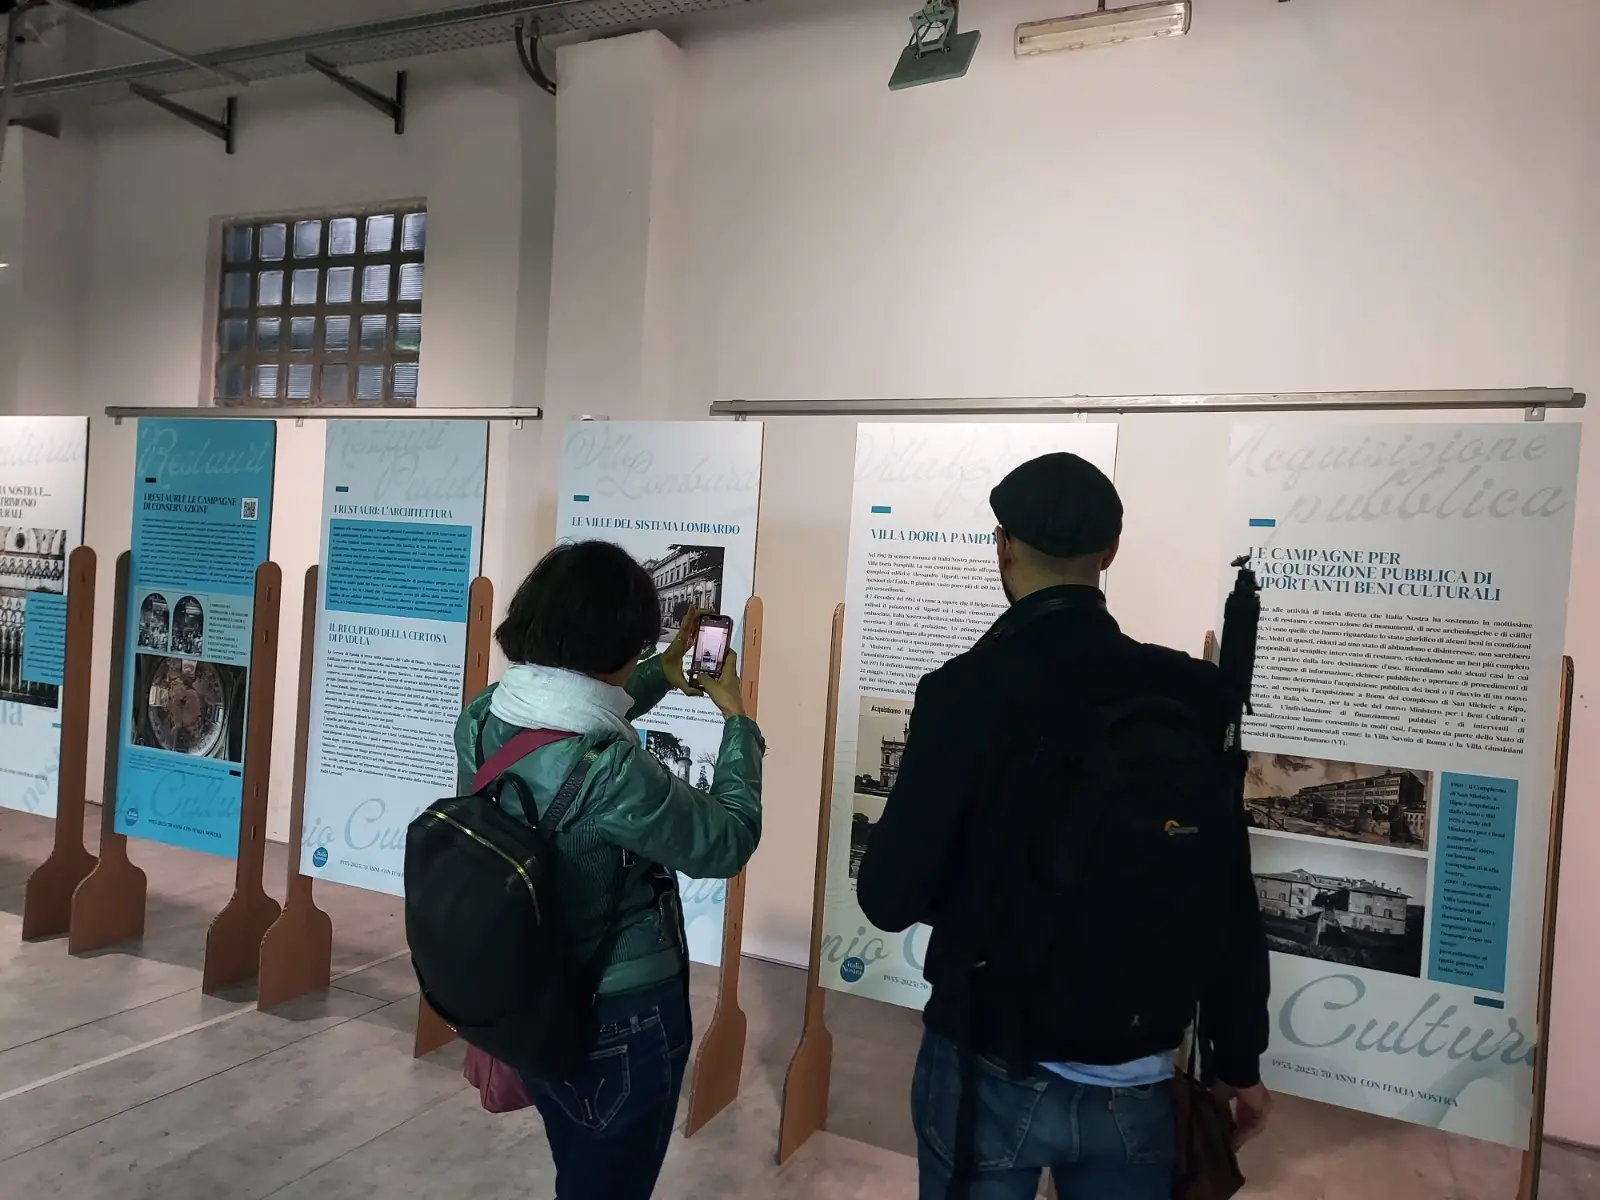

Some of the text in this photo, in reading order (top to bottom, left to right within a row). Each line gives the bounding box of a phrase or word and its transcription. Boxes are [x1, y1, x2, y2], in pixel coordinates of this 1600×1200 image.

[152, 502, 208, 514] CONSERVAZIONE
[198, 496, 237, 506] CAMPAGNE
[1265, 464, 1568, 547] pubblica
[338, 505, 381, 515] RESTAURI:
[381, 506, 453, 519] L'ARCHITETTURA
[571, 516, 741, 535] LE VILLE DEL SISTEMA LOMBARDO
[871, 528, 997, 545] VILLA DORIA PAMPH
[1249, 547, 1401, 565] LE CAMPAGNE PER
[1248, 561, 1493, 585] L'ACQUISIZIONE PUBBLICA DI
[1354, 581, 1393, 595] BENI
[1397, 583, 1501, 601] CULTURALI
[329, 623, 447, 644] IL RECUPERO DELLA CERTOSA
[329, 634, 370, 646] DI PADULA
[1321, 1069, 1331, 1079] 70
[1334, 1073, 1357, 1085] ANNI
[1360, 1078, 1381, 1090] CON
[1382, 1083, 1415, 1098] ITALIA
[1416, 1089, 1458, 1107] NOSTRA
